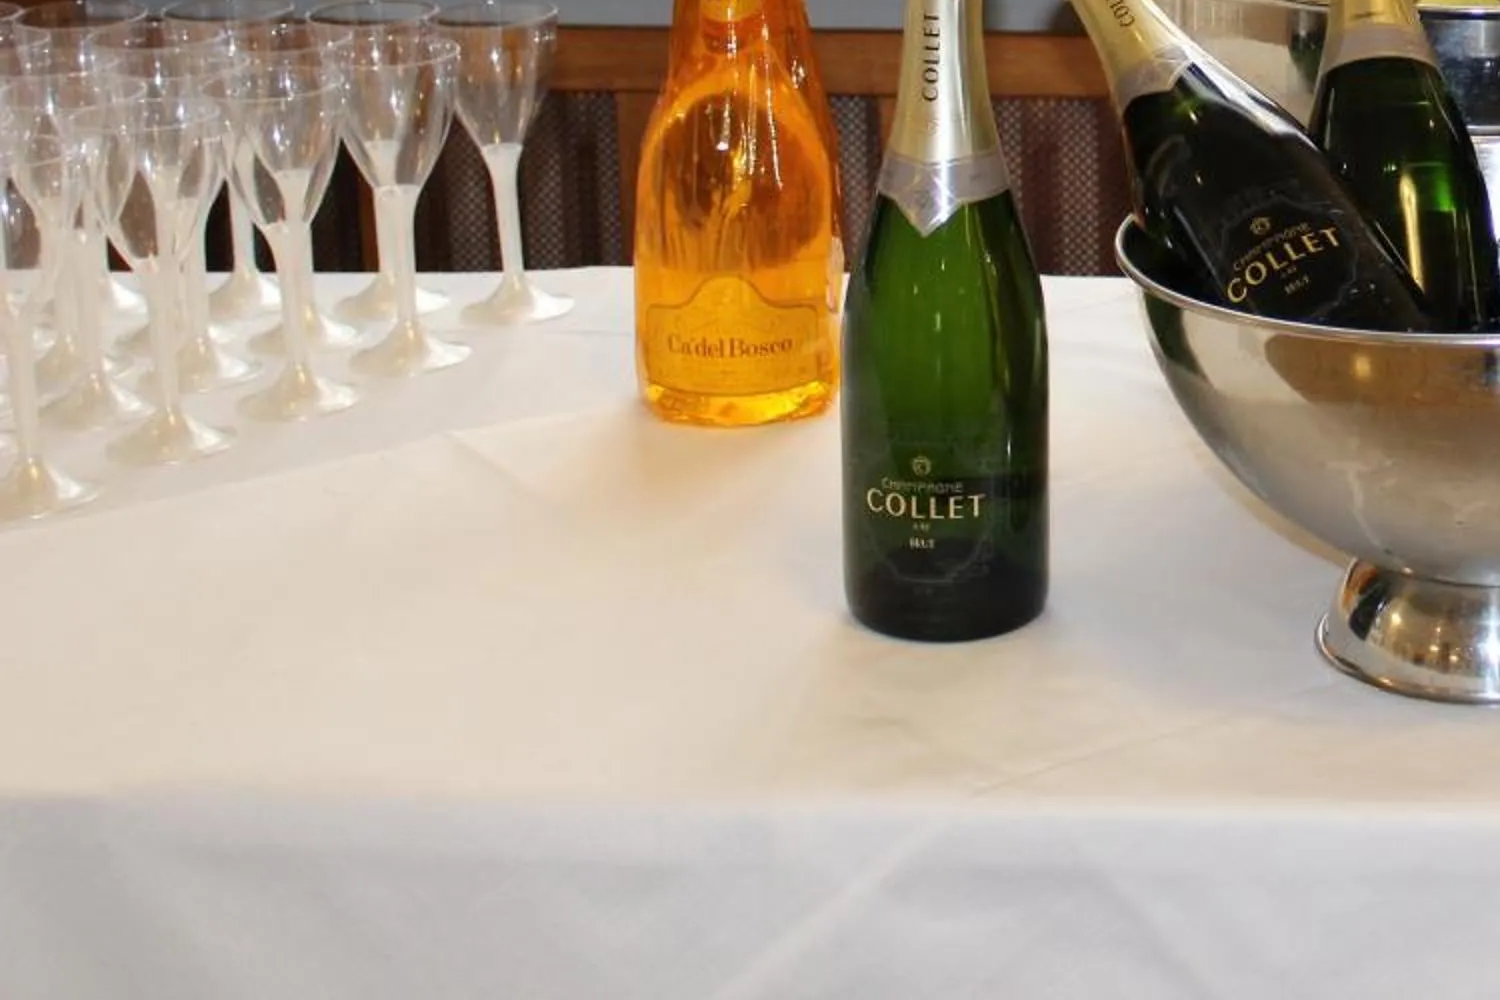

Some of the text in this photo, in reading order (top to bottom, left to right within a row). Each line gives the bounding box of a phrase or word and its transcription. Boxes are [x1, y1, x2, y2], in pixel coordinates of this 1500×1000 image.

[922, 15, 940, 101] COLLET
[1227, 227, 1340, 303] COLLET
[866, 487, 987, 519] COLLET
